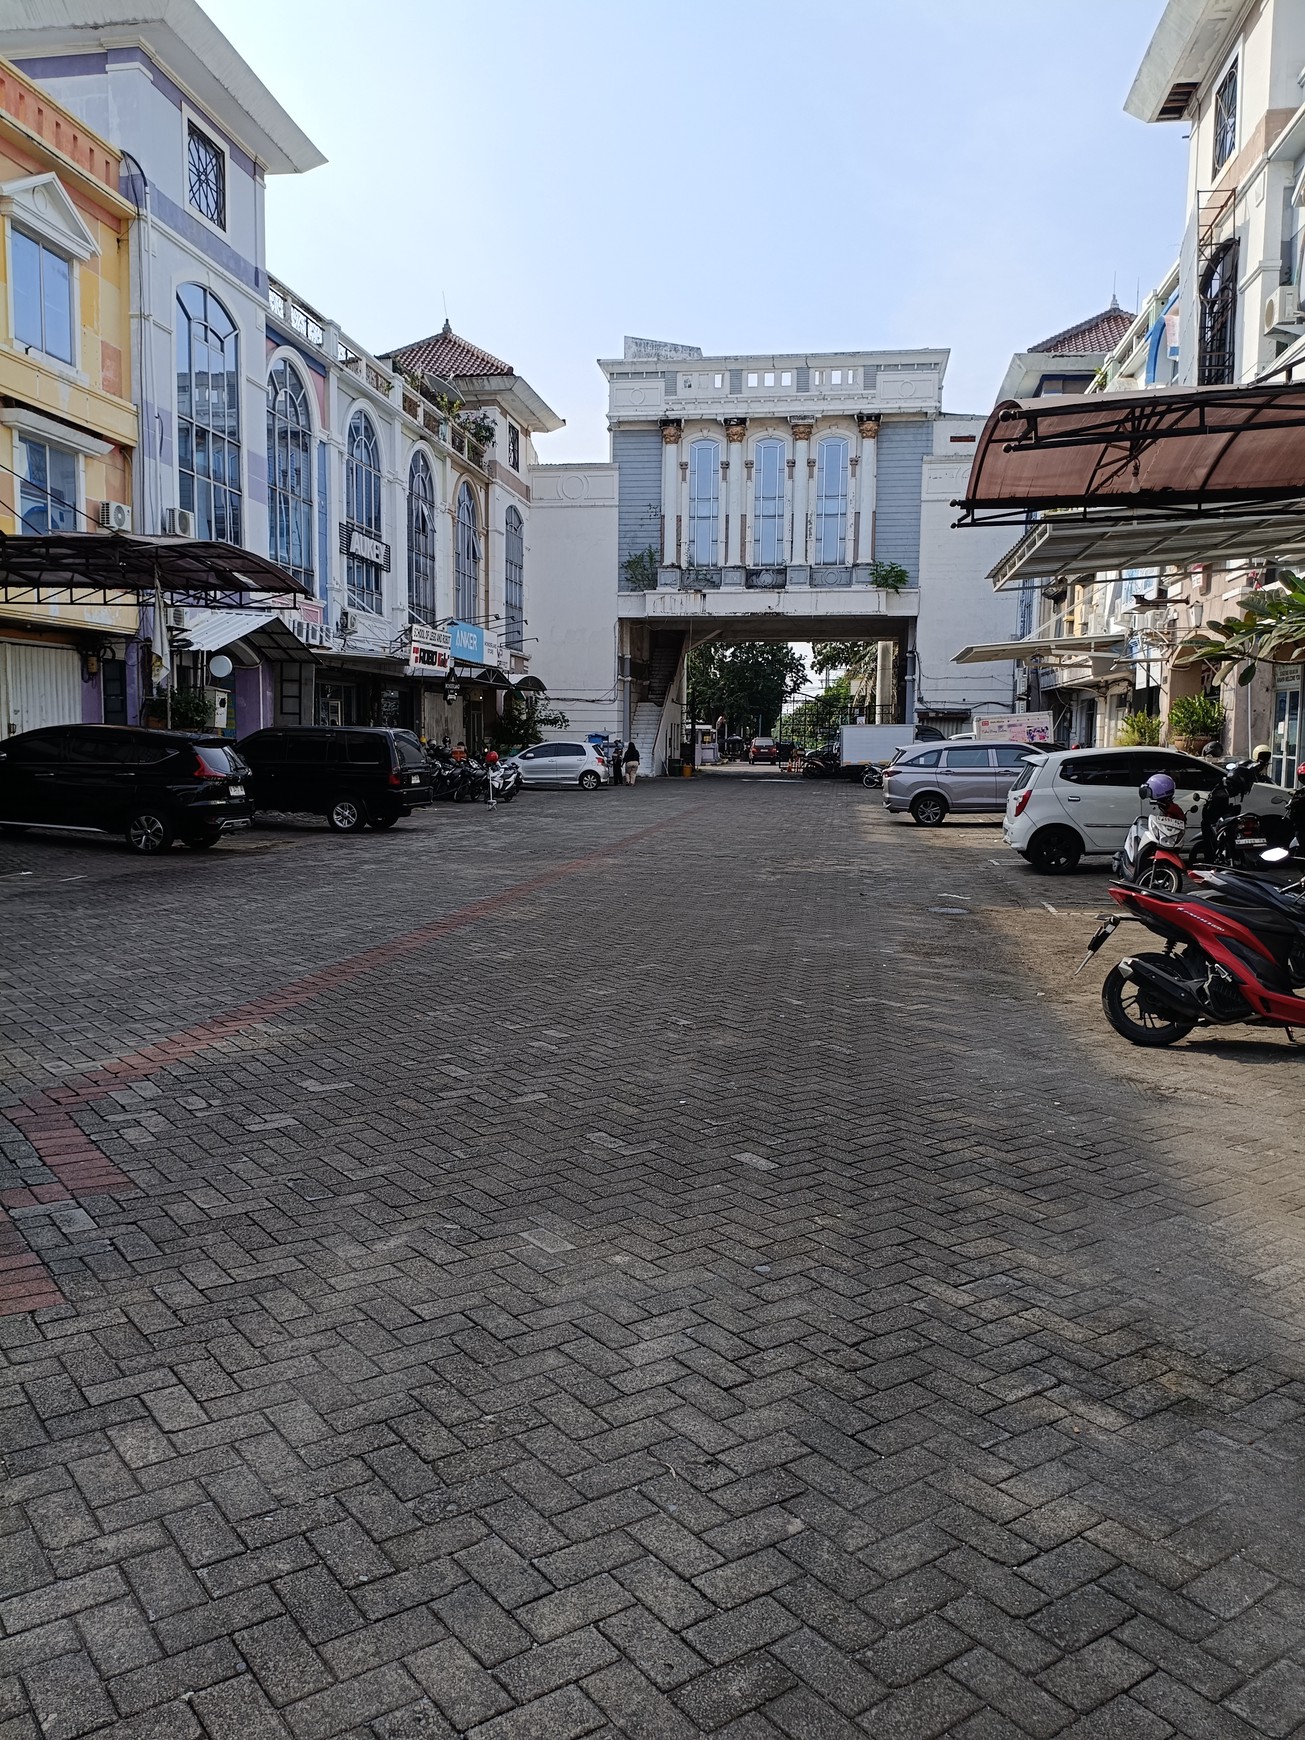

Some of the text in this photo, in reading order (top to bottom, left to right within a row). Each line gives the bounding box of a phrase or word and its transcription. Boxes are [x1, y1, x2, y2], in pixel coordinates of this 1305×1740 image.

[350, 531, 386, 565] AUKEY
[456, 630, 478, 651] ANKER
[419, 648, 438, 666] ROBO
